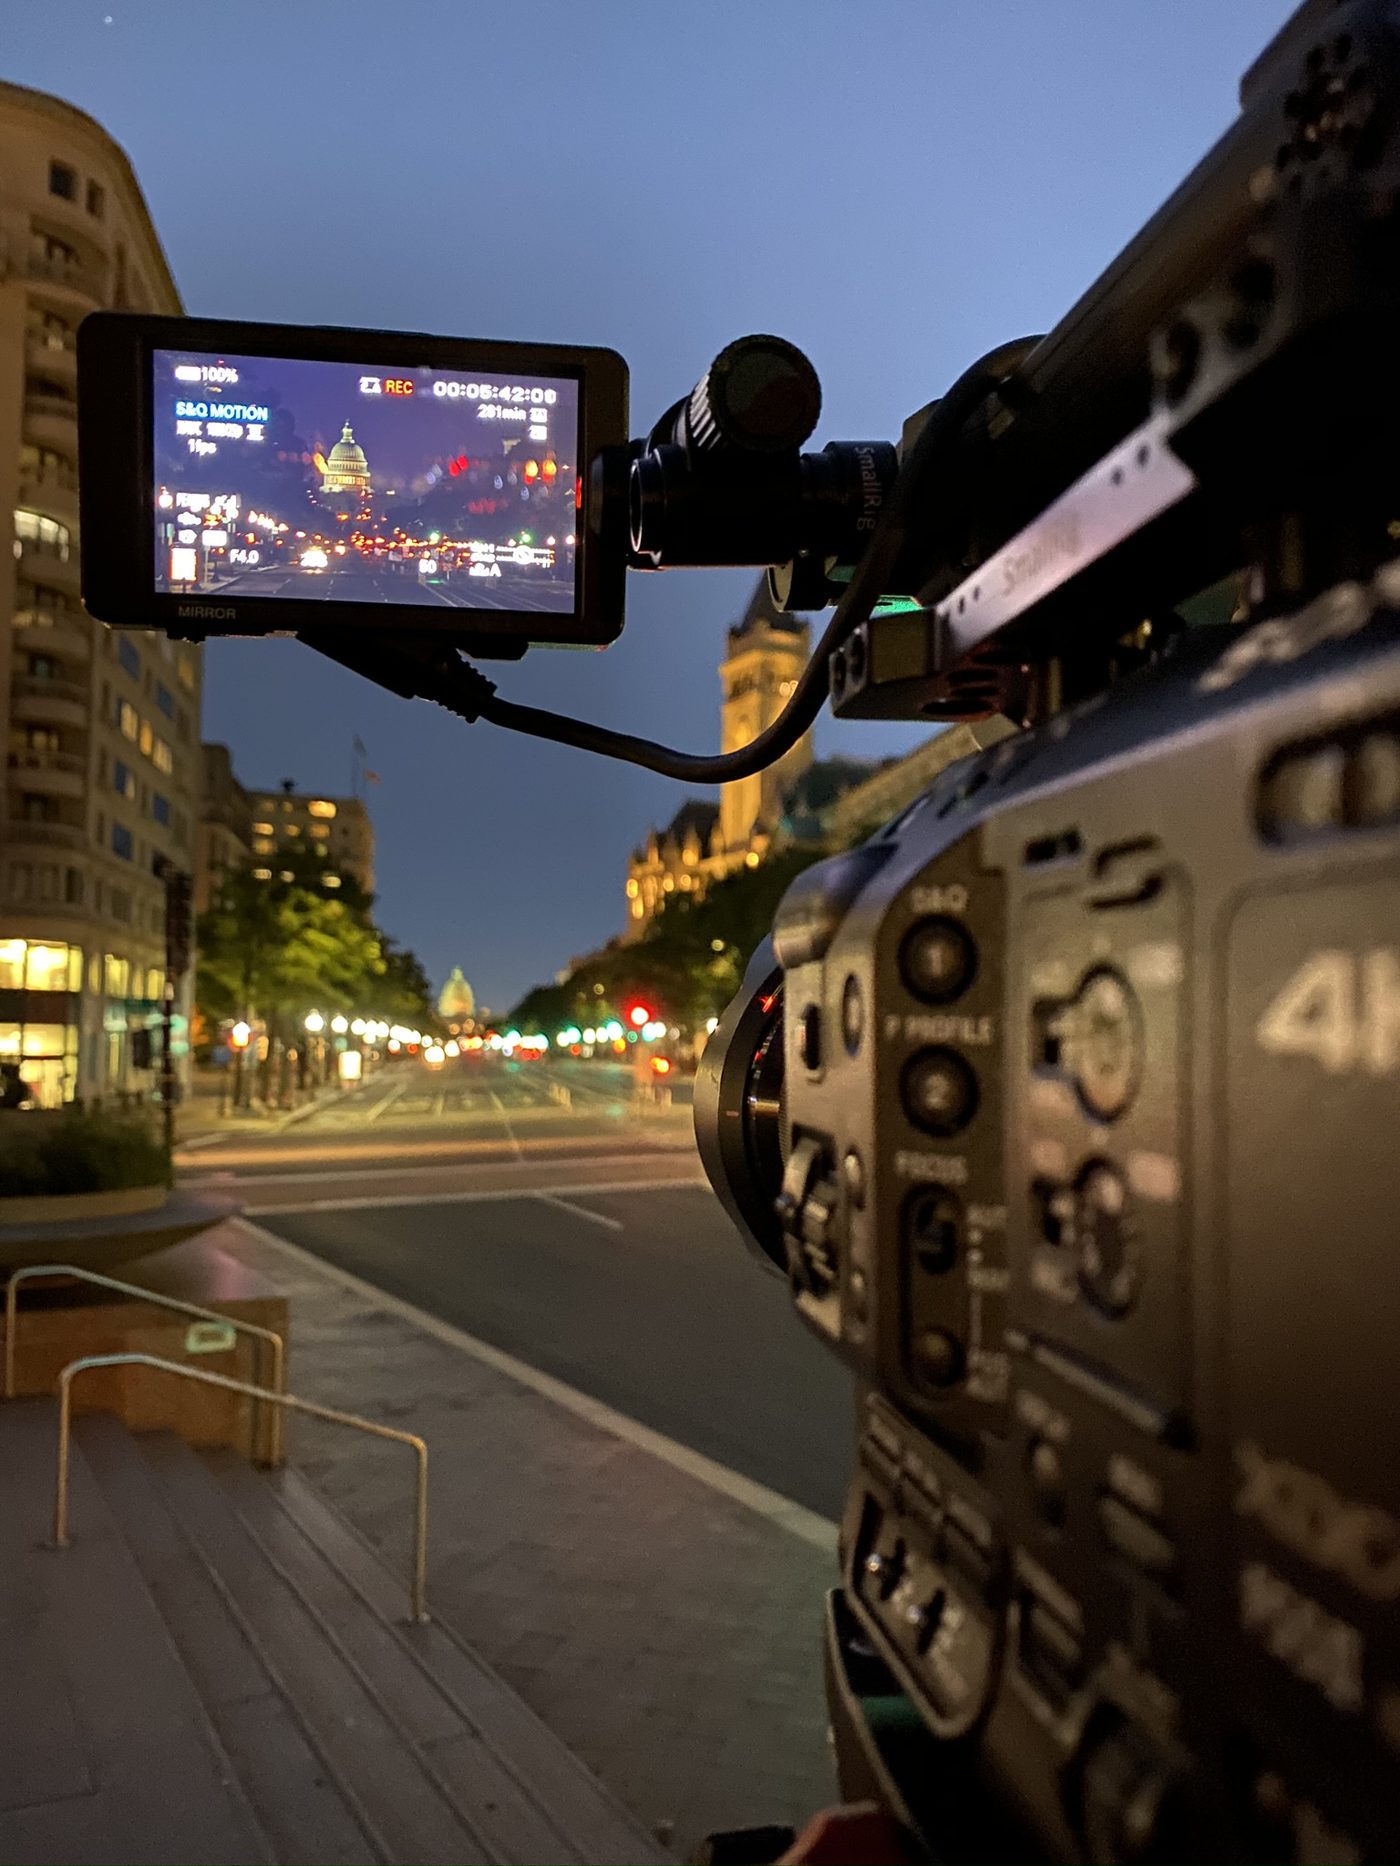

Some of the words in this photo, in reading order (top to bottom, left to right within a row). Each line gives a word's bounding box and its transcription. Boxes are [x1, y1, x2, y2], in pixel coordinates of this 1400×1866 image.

[201, 365, 239, 383] 100%
[385, 379, 414, 395] REC
[176, 401, 208, 418] S&Q
[210, 404, 268, 421] MOTION
[854, 446, 883, 532] SmallRig
[177, 605, 237, 620] MIRROR
